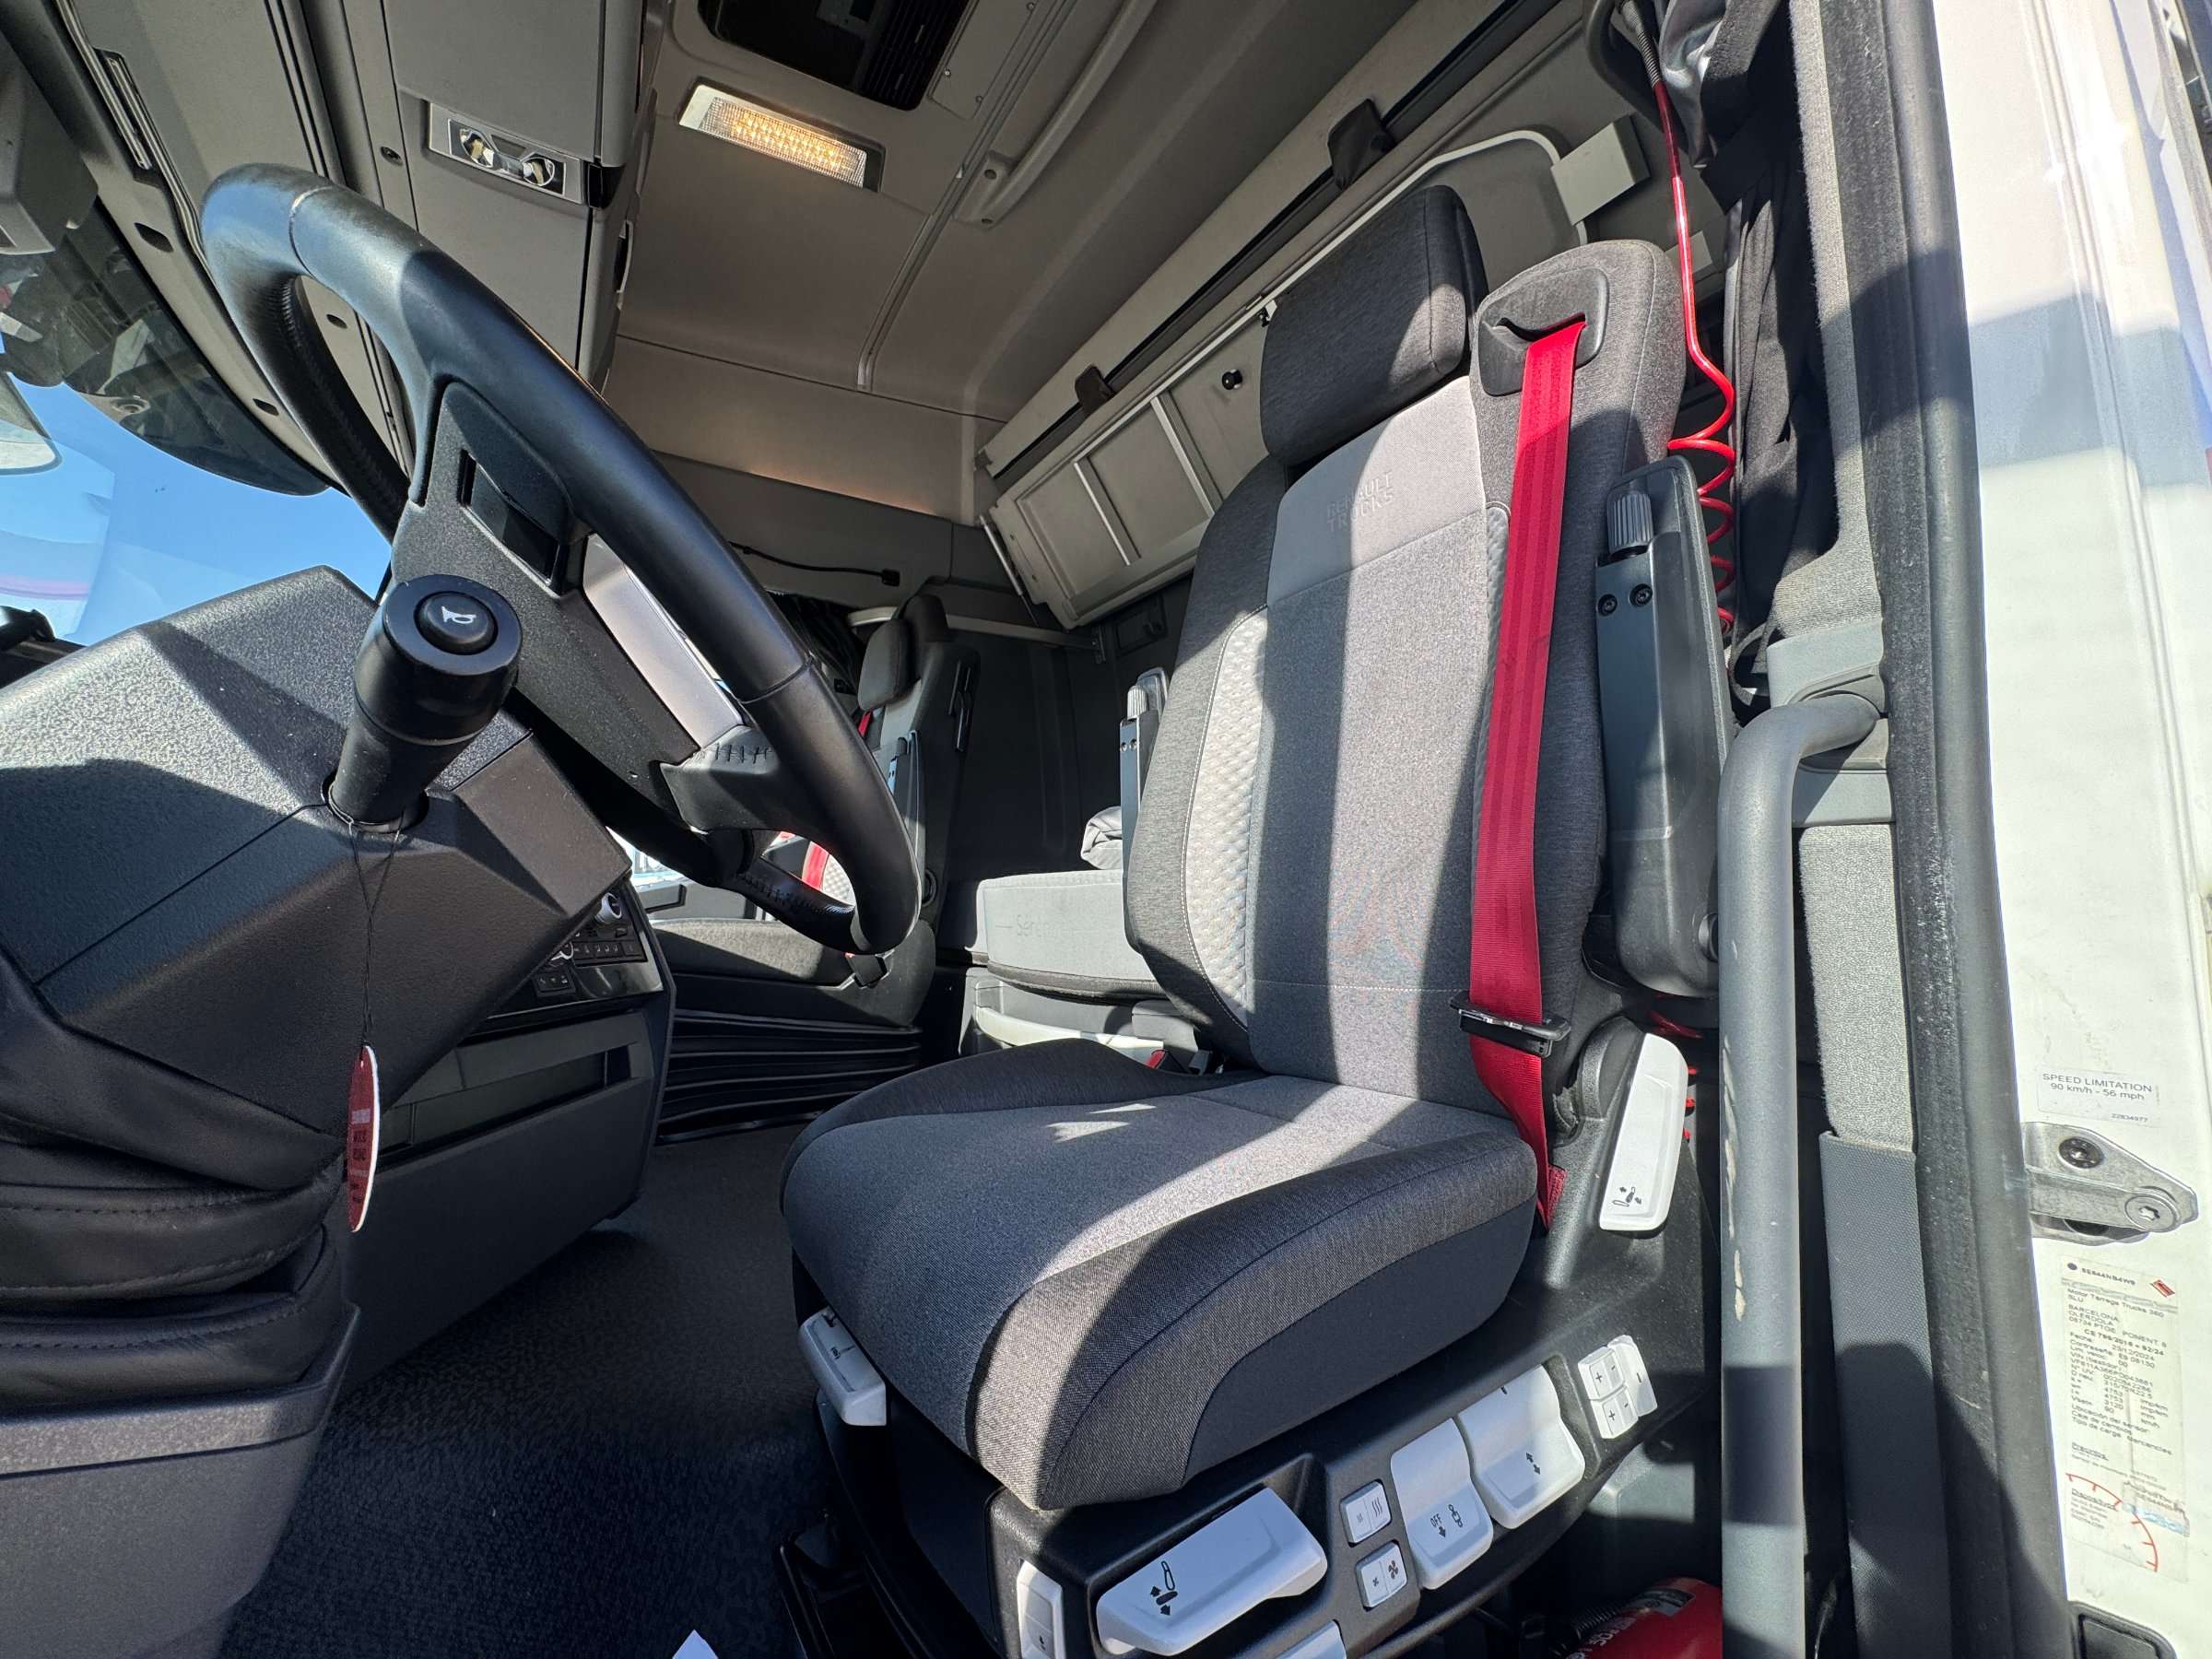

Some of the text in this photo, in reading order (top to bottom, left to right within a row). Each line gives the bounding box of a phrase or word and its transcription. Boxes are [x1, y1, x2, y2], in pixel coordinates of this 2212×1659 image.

[1326, 469, 1393, 518] RENAULT
[1327, 491, 1394, 532] TRUCKS
[2042, 1073, 2153, 1093] SPEED LIMITATION
[2051, 1083, 2064, 1091] 90
[2066, 1085, 2093, 1095] km/h
[2120, 1091, 2145, 1100] mph
[1430, 1513, 1442, 1528] OFF
